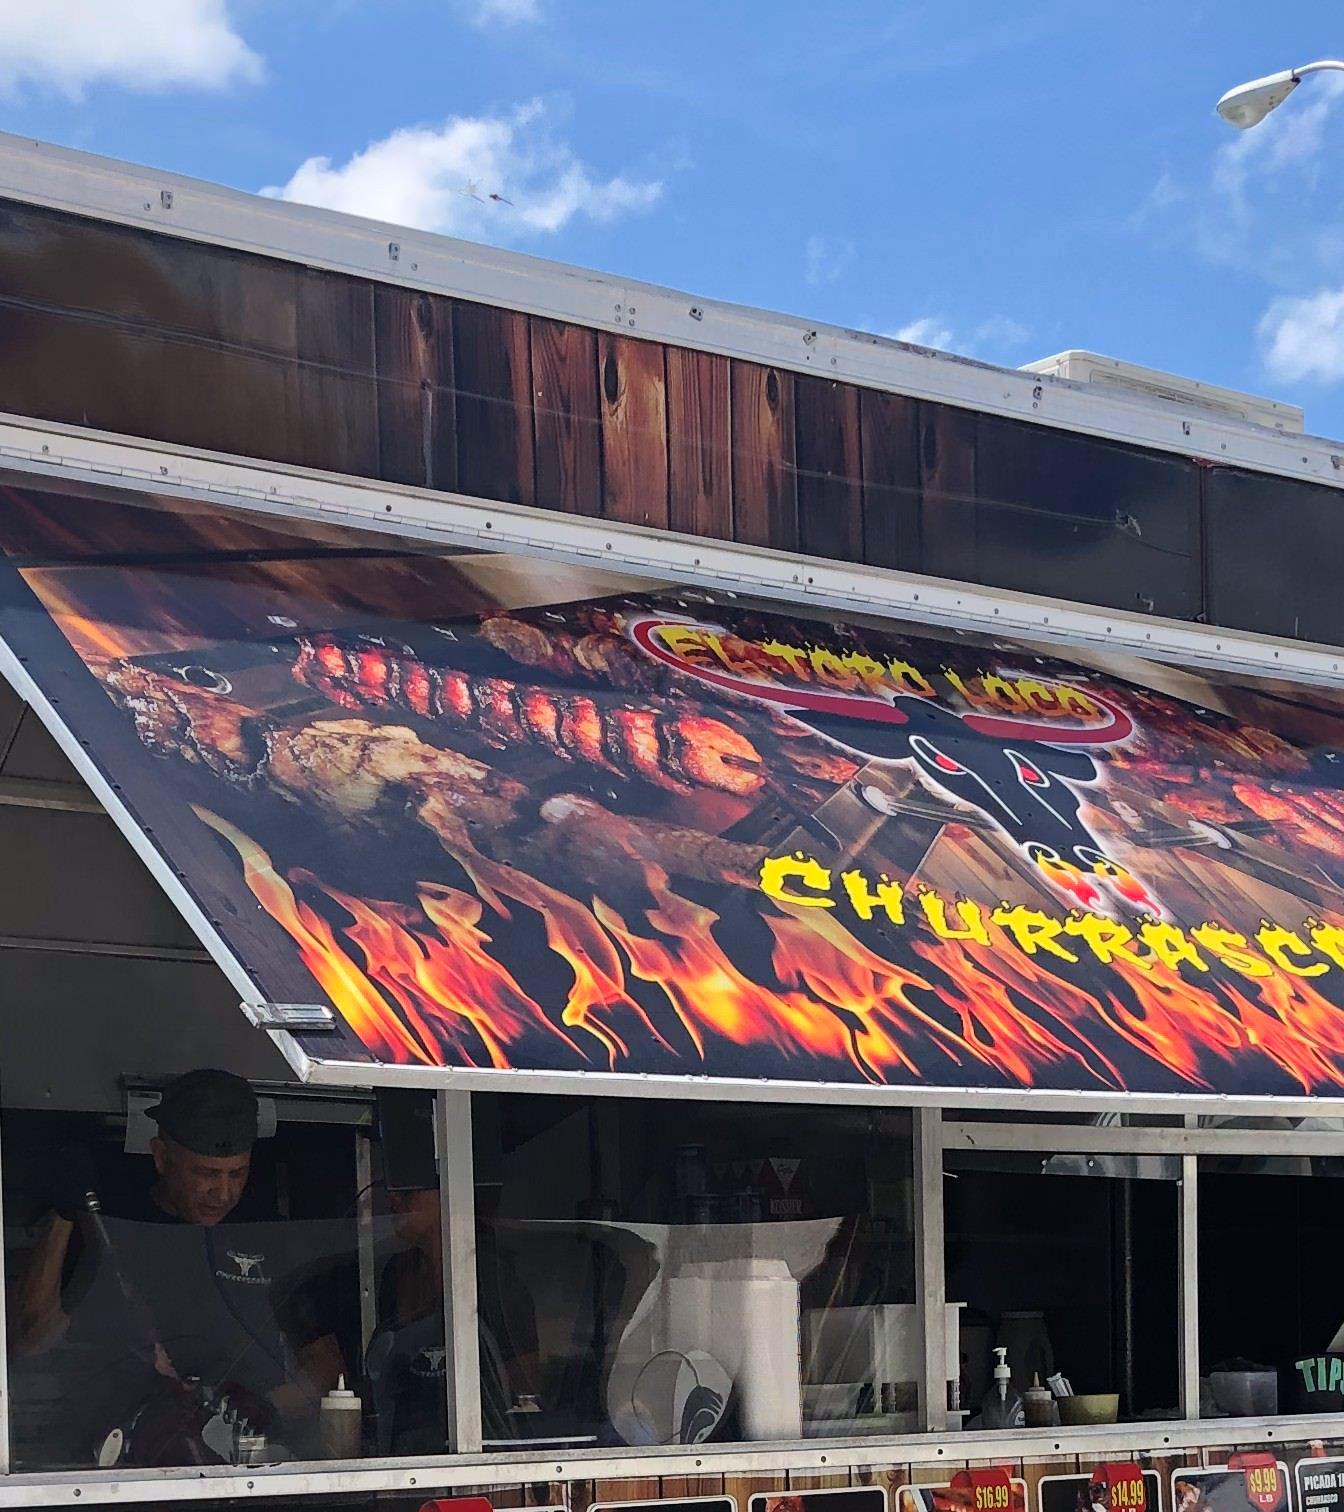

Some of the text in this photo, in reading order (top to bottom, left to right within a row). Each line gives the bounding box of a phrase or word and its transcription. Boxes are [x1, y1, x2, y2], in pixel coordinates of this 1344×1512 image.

[656, 623, 1105, 726] EL TORO LOCO
[1249, 1468, 1277, 1493] $9.99
[1304, 1474, 1336, 1490] PICADA
[976, 1486, 1008, 1509] $16.99
[1112, 1480, 1144, 1507] $14.99
[1259, 1494, 1273, 1503] LB
